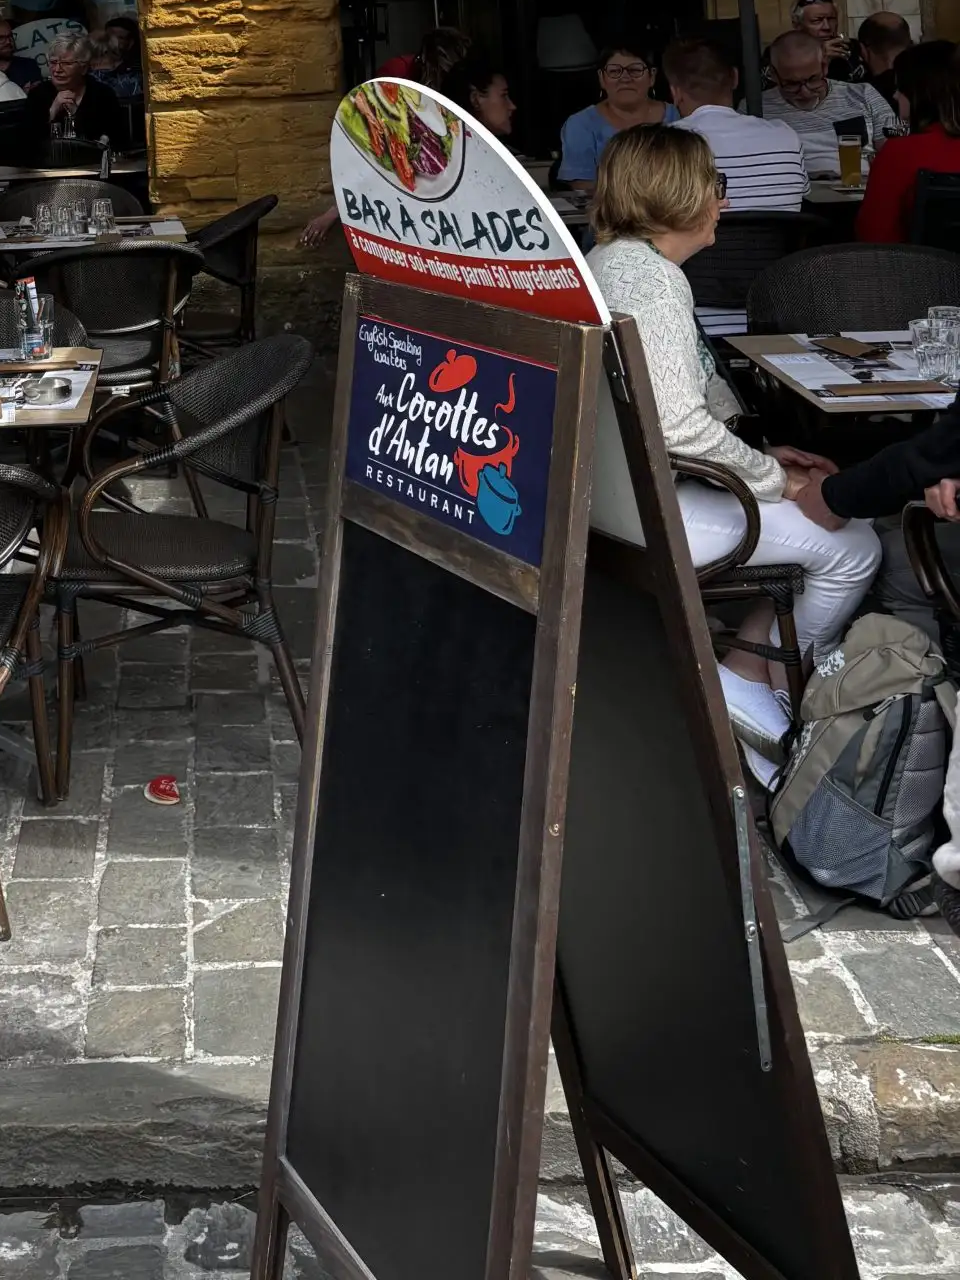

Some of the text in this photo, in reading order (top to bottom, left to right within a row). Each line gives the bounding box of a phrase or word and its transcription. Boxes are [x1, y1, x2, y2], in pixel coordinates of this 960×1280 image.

[342, 187, 550, 256] BAR À SALADES
[349, 227, 581, 296] à composer soi-même parmi 50 ingrédients
[359, 324, 388, 352] English
[375, 373, 500, 449] Aux Cocottes
[368, 413, 454, 485] d'Antan
[366, 465, 475, 525] RESTAURANT
